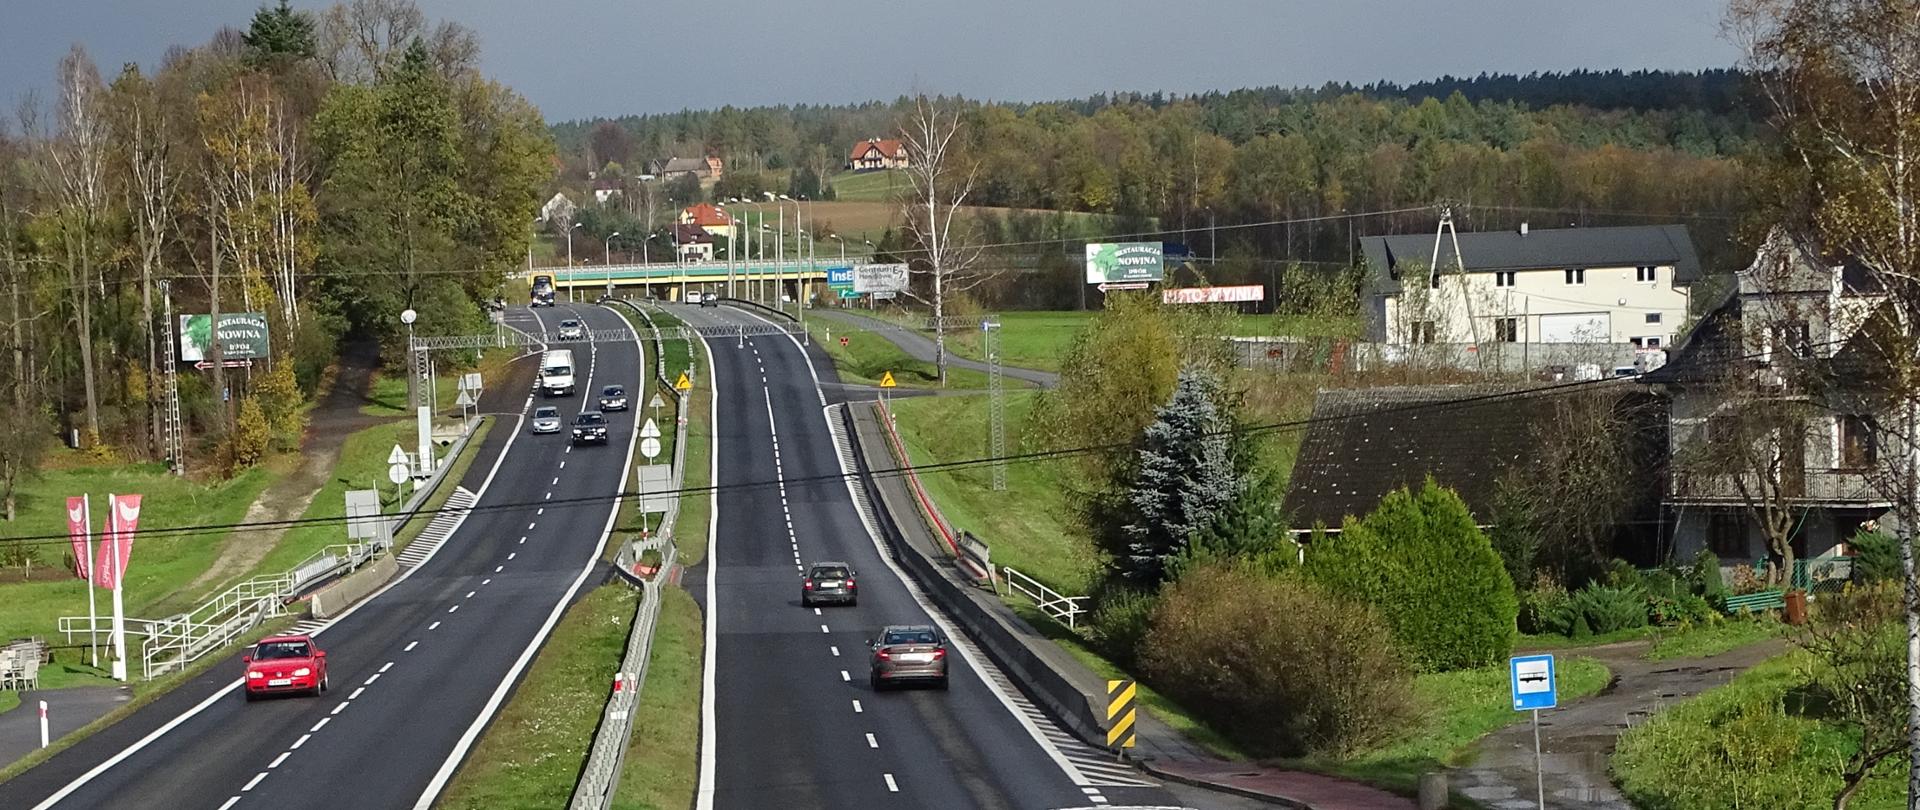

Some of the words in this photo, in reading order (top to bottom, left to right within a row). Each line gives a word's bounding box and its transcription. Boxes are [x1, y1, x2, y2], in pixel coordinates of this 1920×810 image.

[1114, 246, 1160, 257] RESTAURACJA
[1118, 256, 1156, 265] NOWINA
[832, 270, 853, 281] InsE
[217, 317, 265, 329] ESTAURACJA
[217, 329, 261, 339] NOWINA
